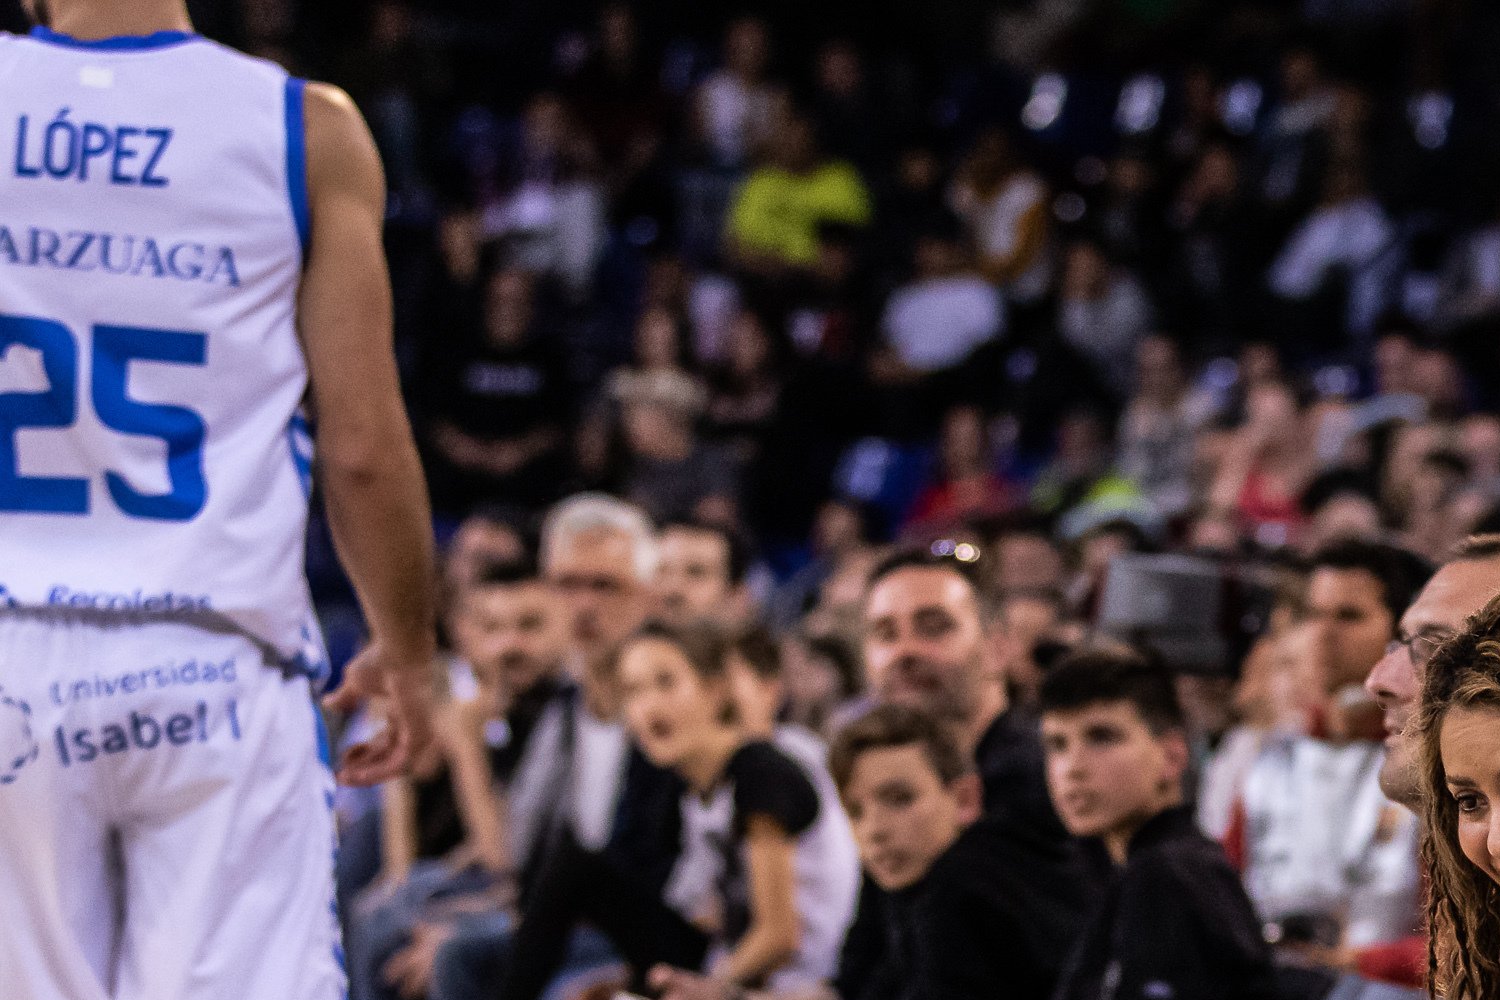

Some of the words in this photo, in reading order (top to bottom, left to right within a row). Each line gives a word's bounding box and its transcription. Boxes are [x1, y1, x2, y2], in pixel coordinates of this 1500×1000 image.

[15, 107, 175, 188] LÓPEZ
[0, 314, 209, 524] 25
[54, 700, 208, 768] Isabel
